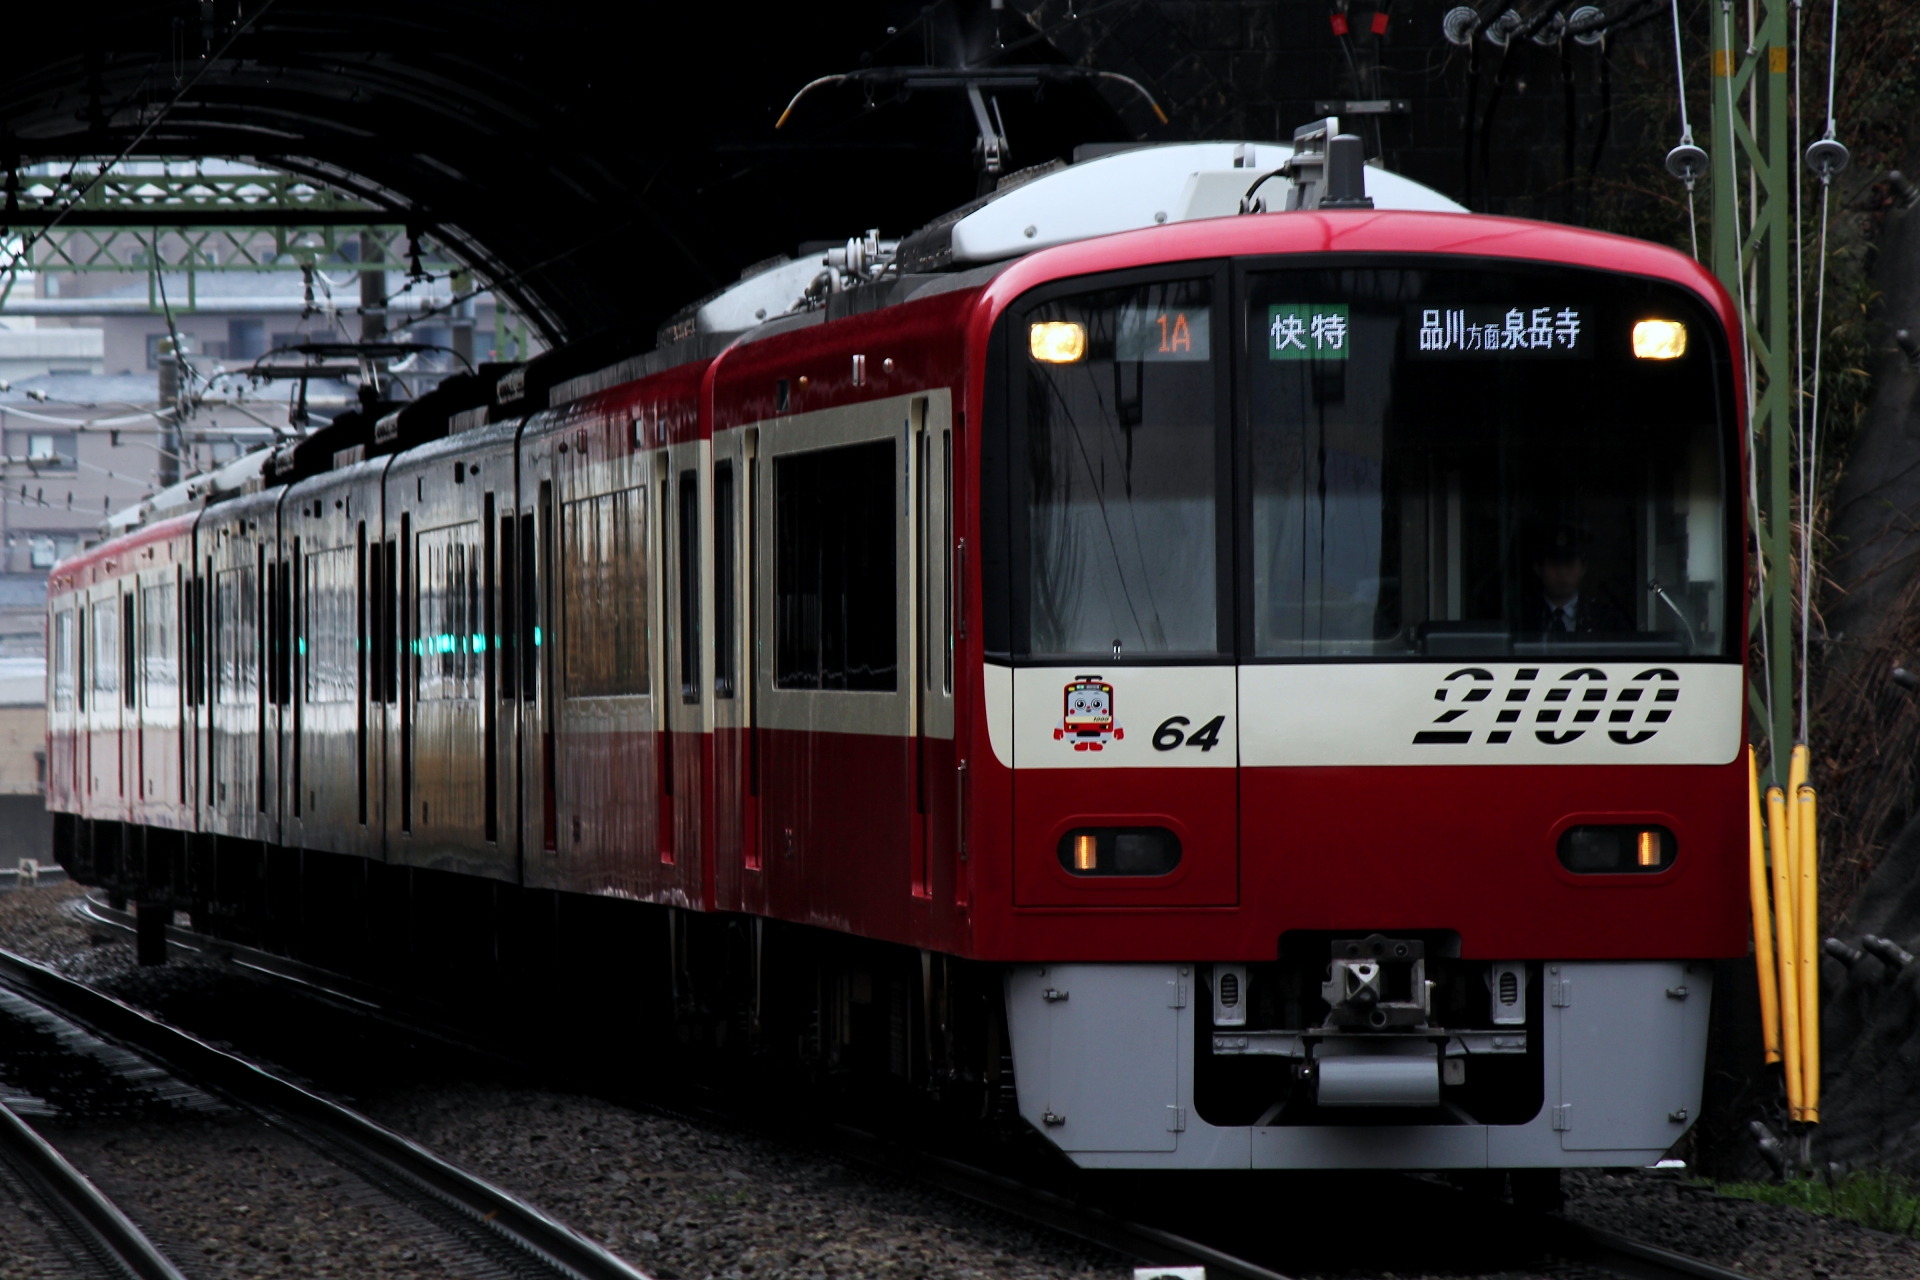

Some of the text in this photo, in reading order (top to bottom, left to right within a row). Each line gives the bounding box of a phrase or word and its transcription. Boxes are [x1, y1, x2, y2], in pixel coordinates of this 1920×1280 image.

[1157, 313, 1191, 352] 1A
[1270, 313, 1347, 350] 快特
[1419, 307, 1581, 351] 品川方面泉岳寺
[1412, 667, 1680, 745] 2100
[1151, 715, 1226, 752] 64
